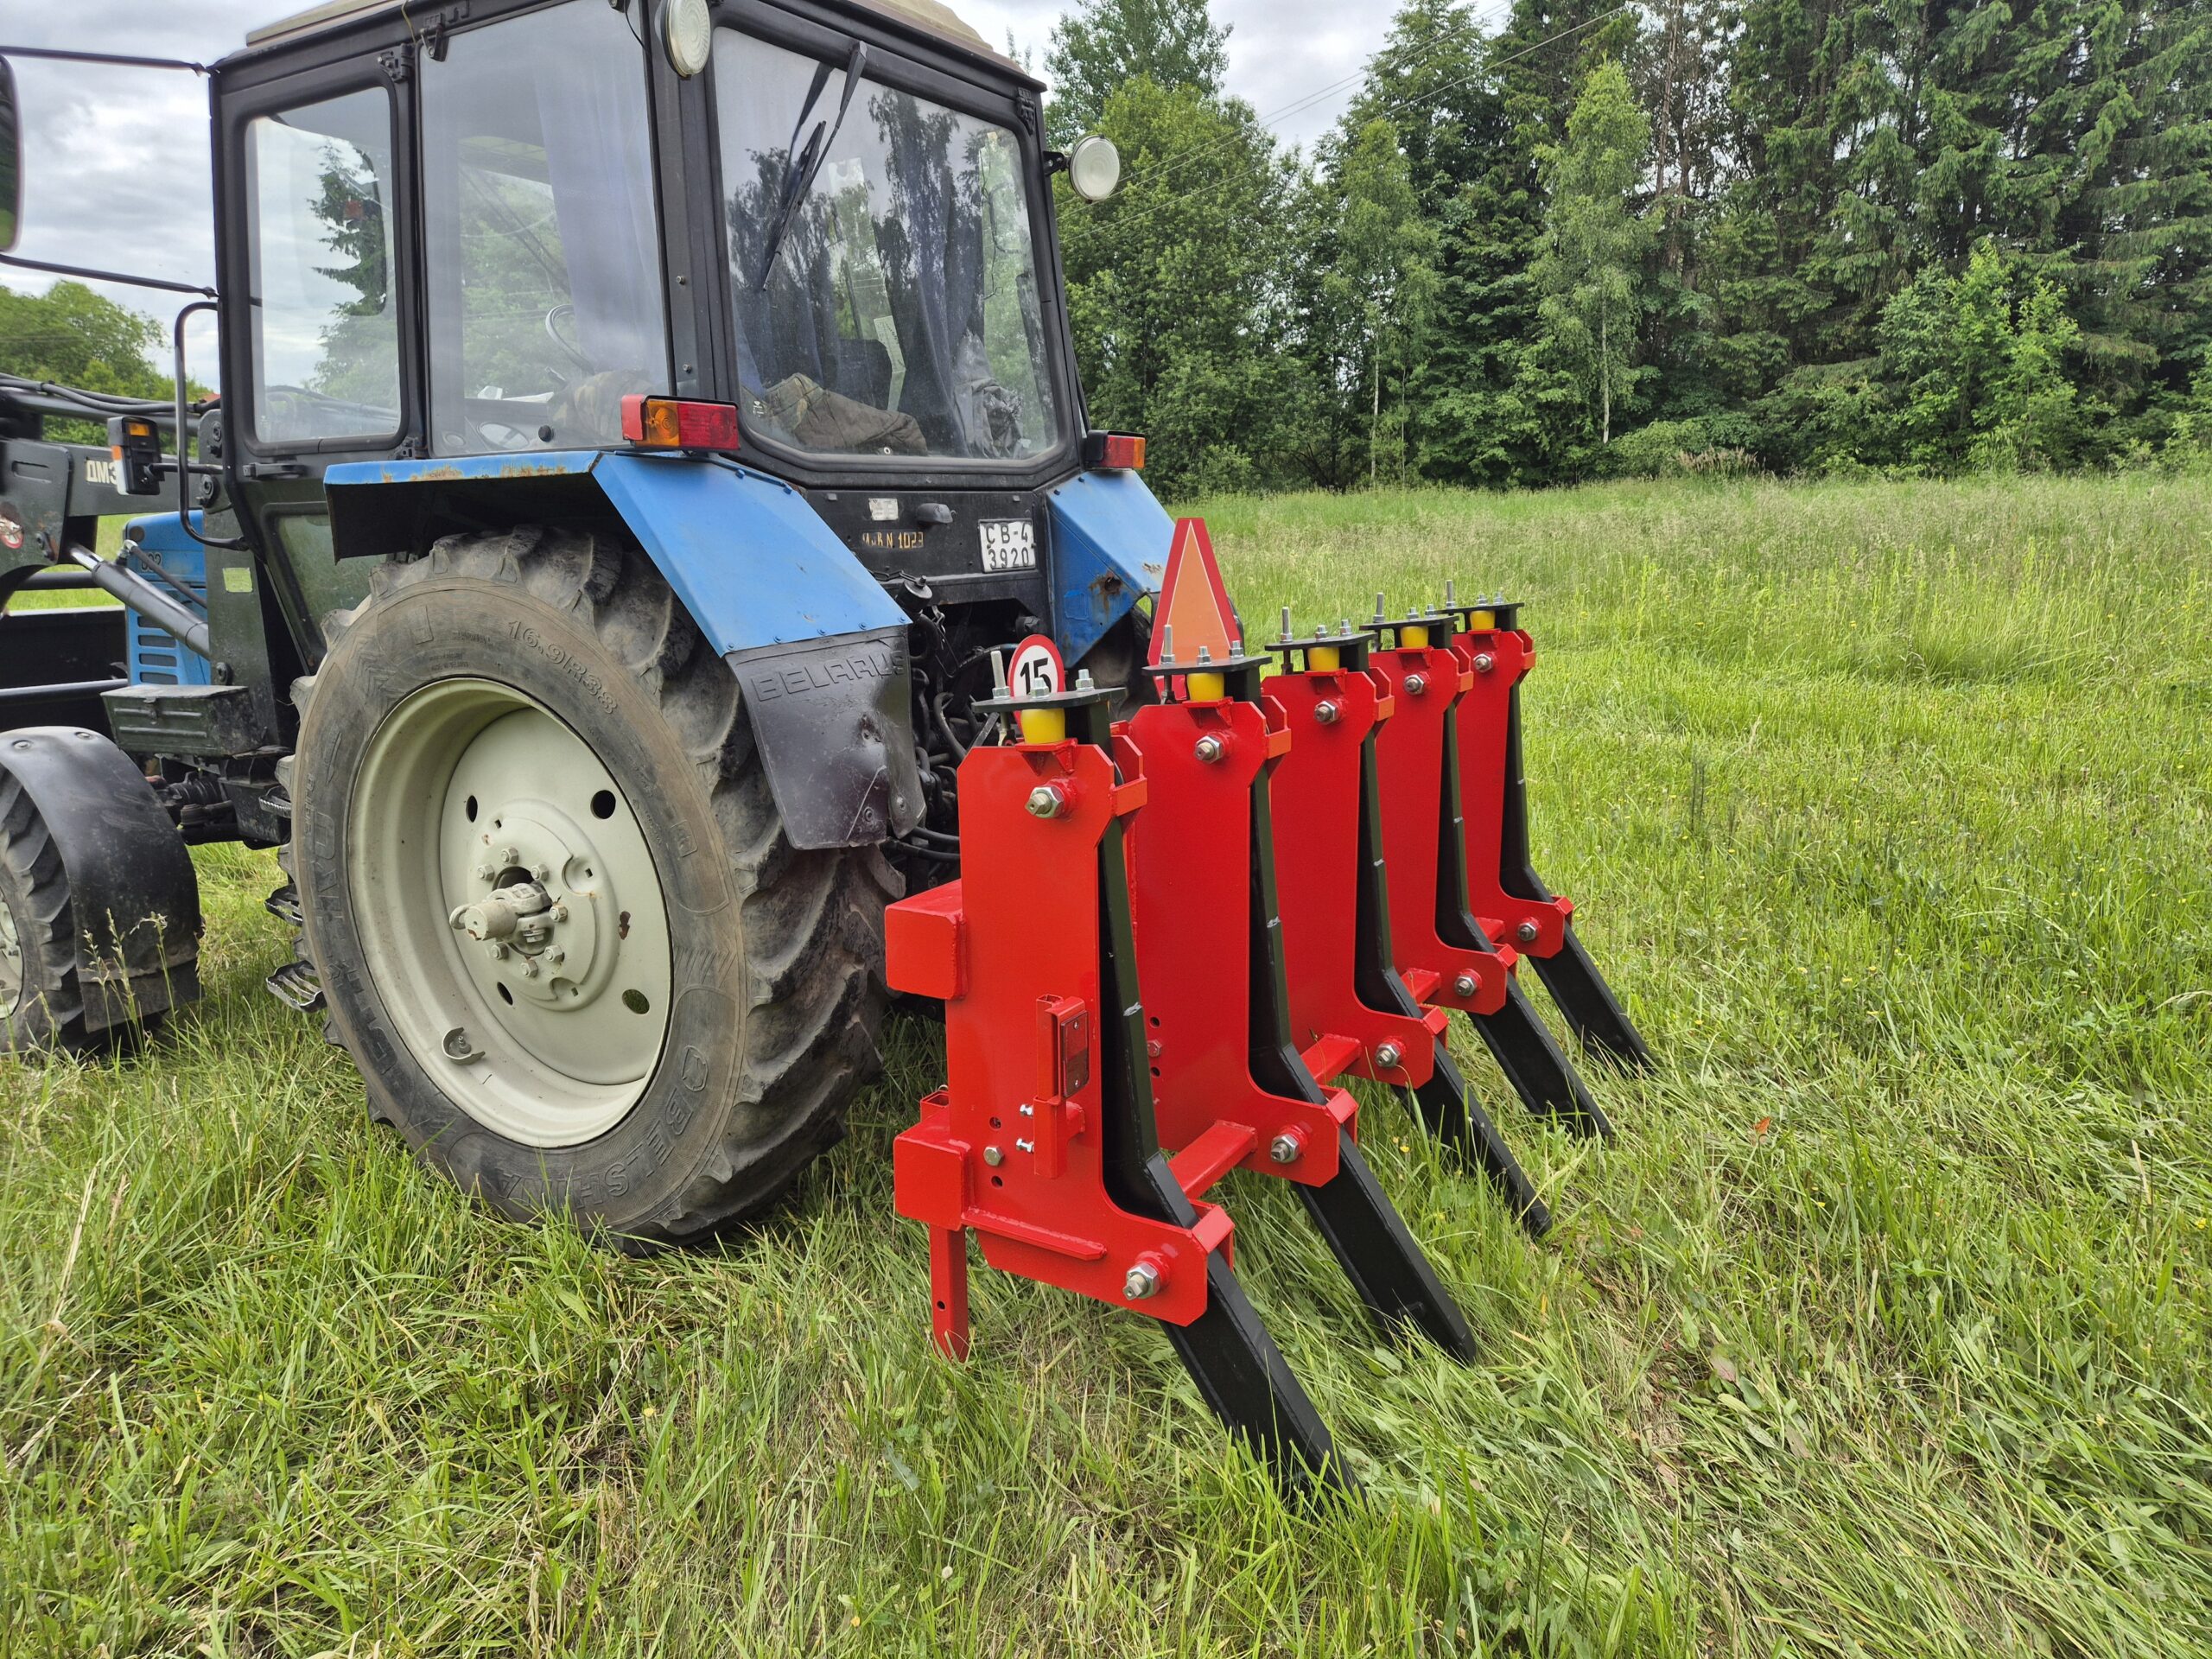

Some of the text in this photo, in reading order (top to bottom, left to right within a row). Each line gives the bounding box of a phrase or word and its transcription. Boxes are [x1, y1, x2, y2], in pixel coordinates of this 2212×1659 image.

[988, 547, 1030, 569] 3920
[750, 650, 905, 702] BELARUS
[1020, 657, 1052, 695] 15
